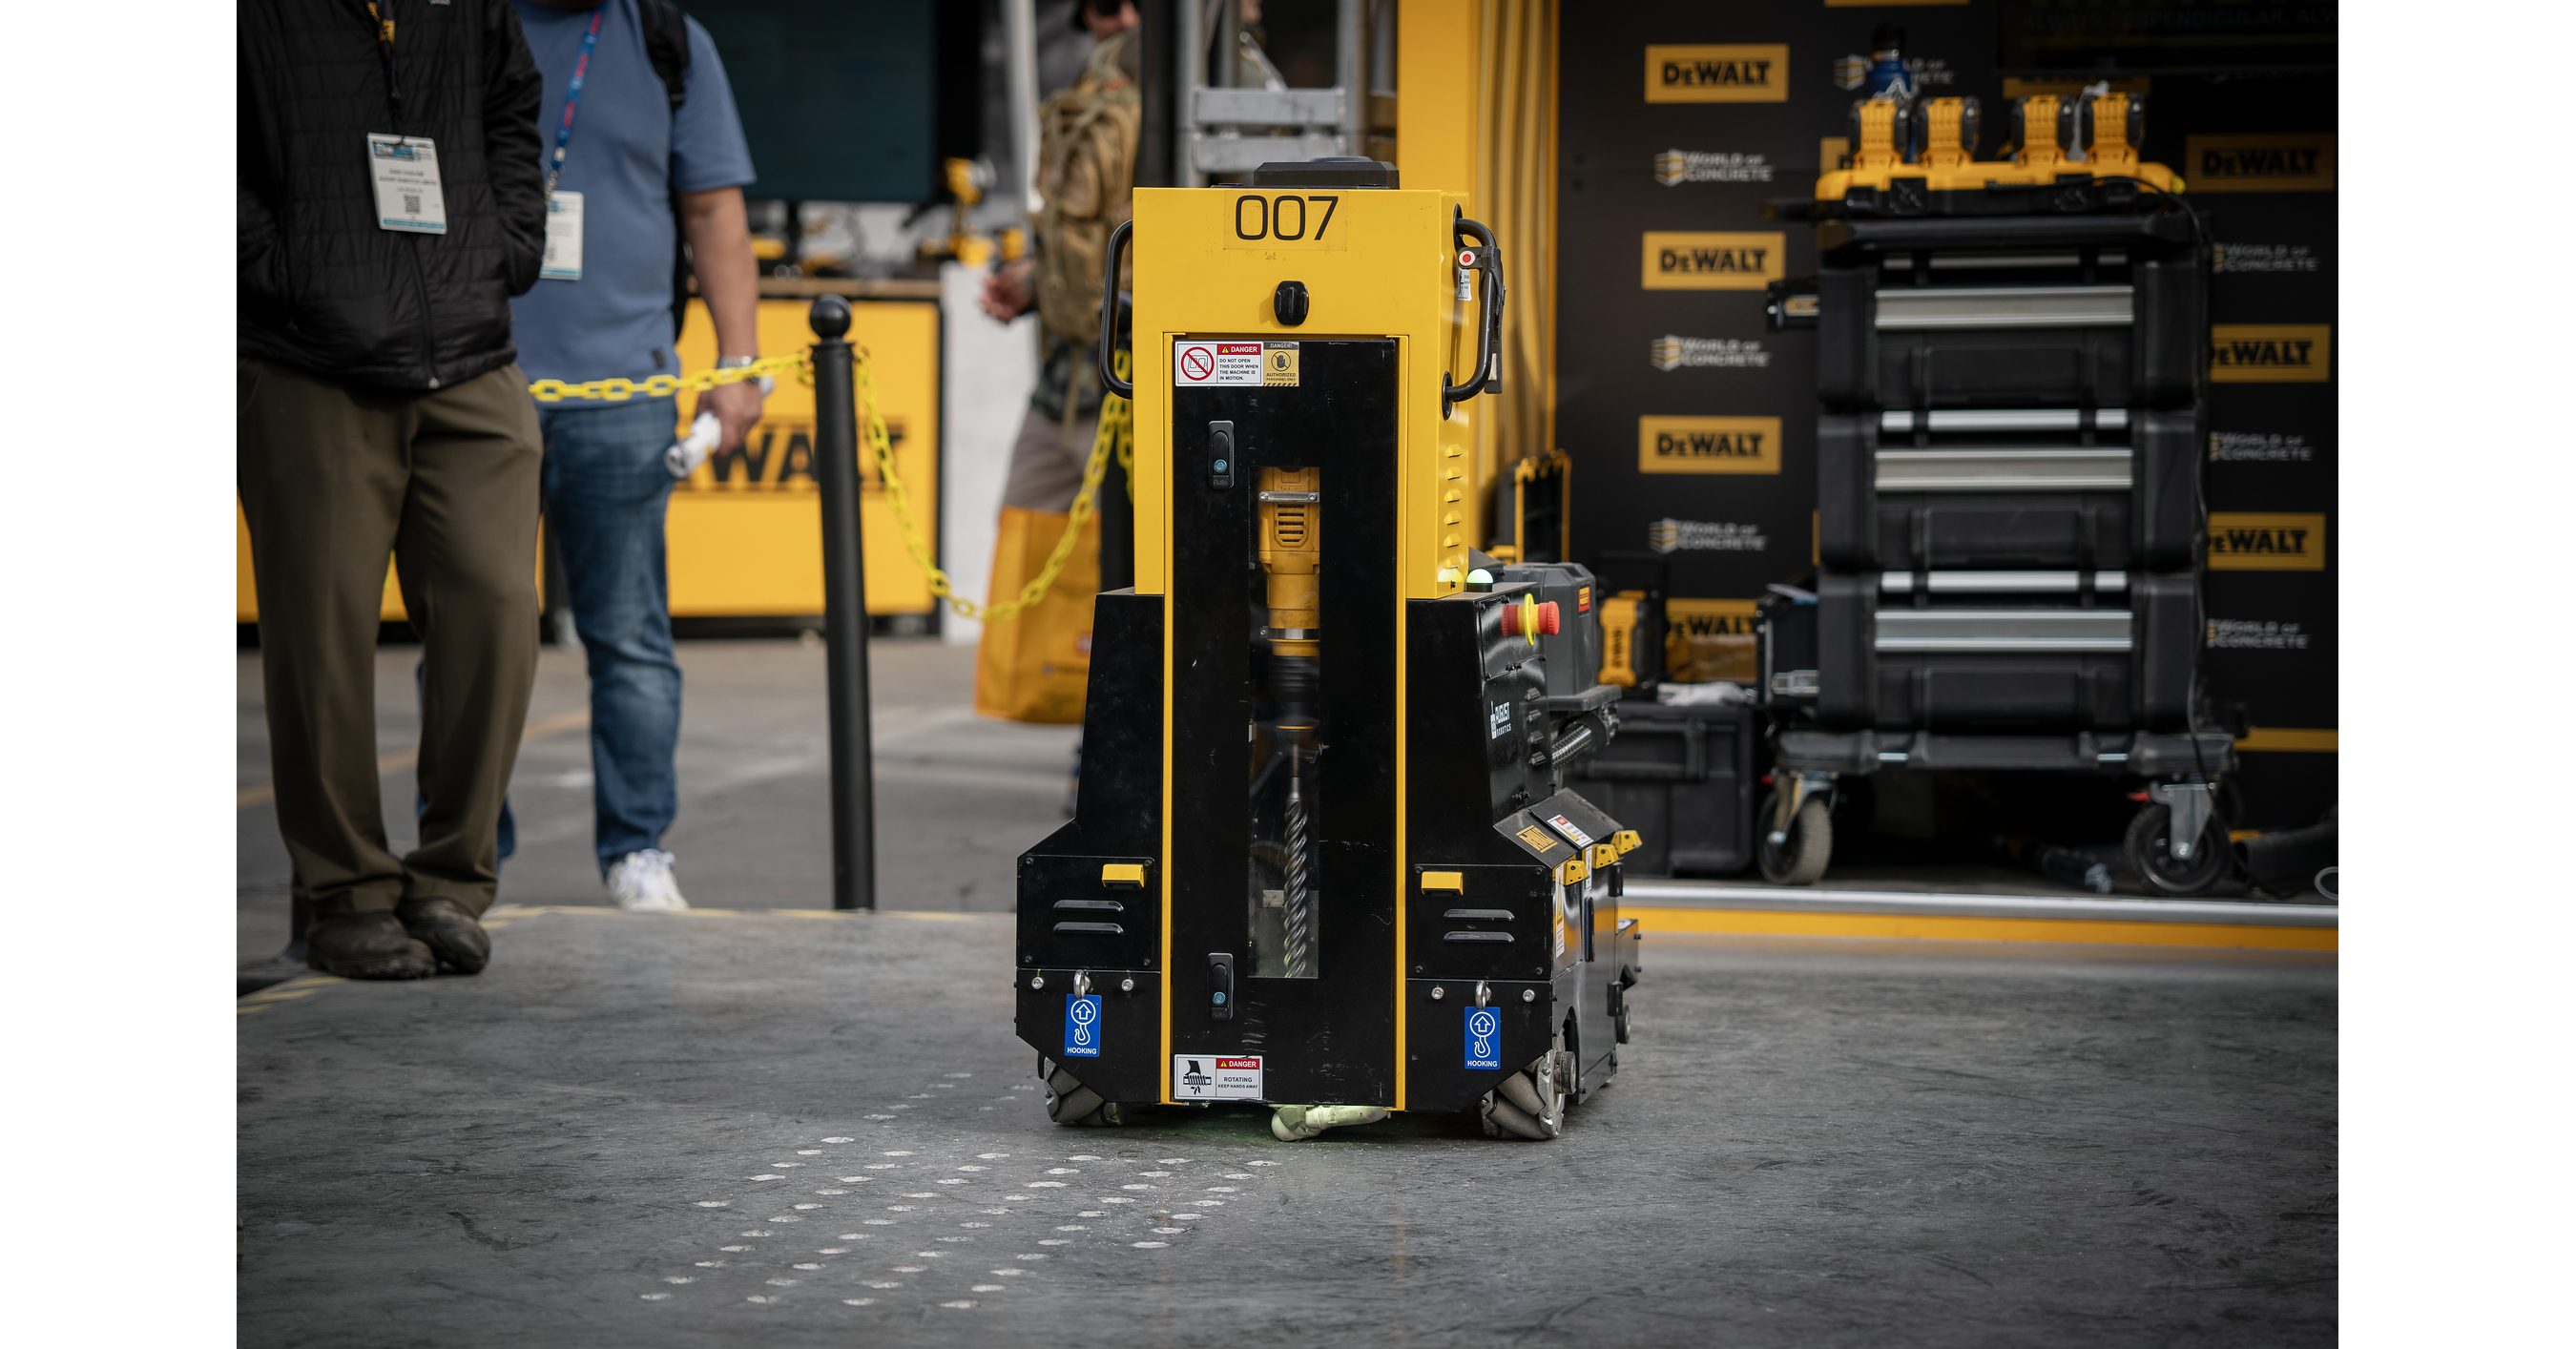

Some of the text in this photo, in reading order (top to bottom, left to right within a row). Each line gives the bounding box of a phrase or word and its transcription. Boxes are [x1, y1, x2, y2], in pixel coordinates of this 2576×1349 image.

[1684, 152, 1765, 166] WORLD OF
[1684, 165, 1773, 181] CONCRETE
[1236, 195, 1339, 240] 007
[2226, 244, 2288, 258] WORLD
[2226, 257, 2319, 272] CONCRETE
[1680, 338, 1761, 352] WORLD OF
[1680, 351, 1769, 366] CONCRETE
[2211, 341, 2313, 365] EWALT
[2220, 433, 2283, 447] WORLD
[2219, 446, 2313, 461] CONCRETE
[1676, 521, 1738, 535] WORLD
[1677, 534, 1767, 550] CONCRETE
[2209, 529, 2307, 553] EWALT
[2217, 620, 2279, 633] WORLD
[2215, 633, 2309, 648] CONCRETE
[1067, 1047, 1097, 1055] HOOKING
